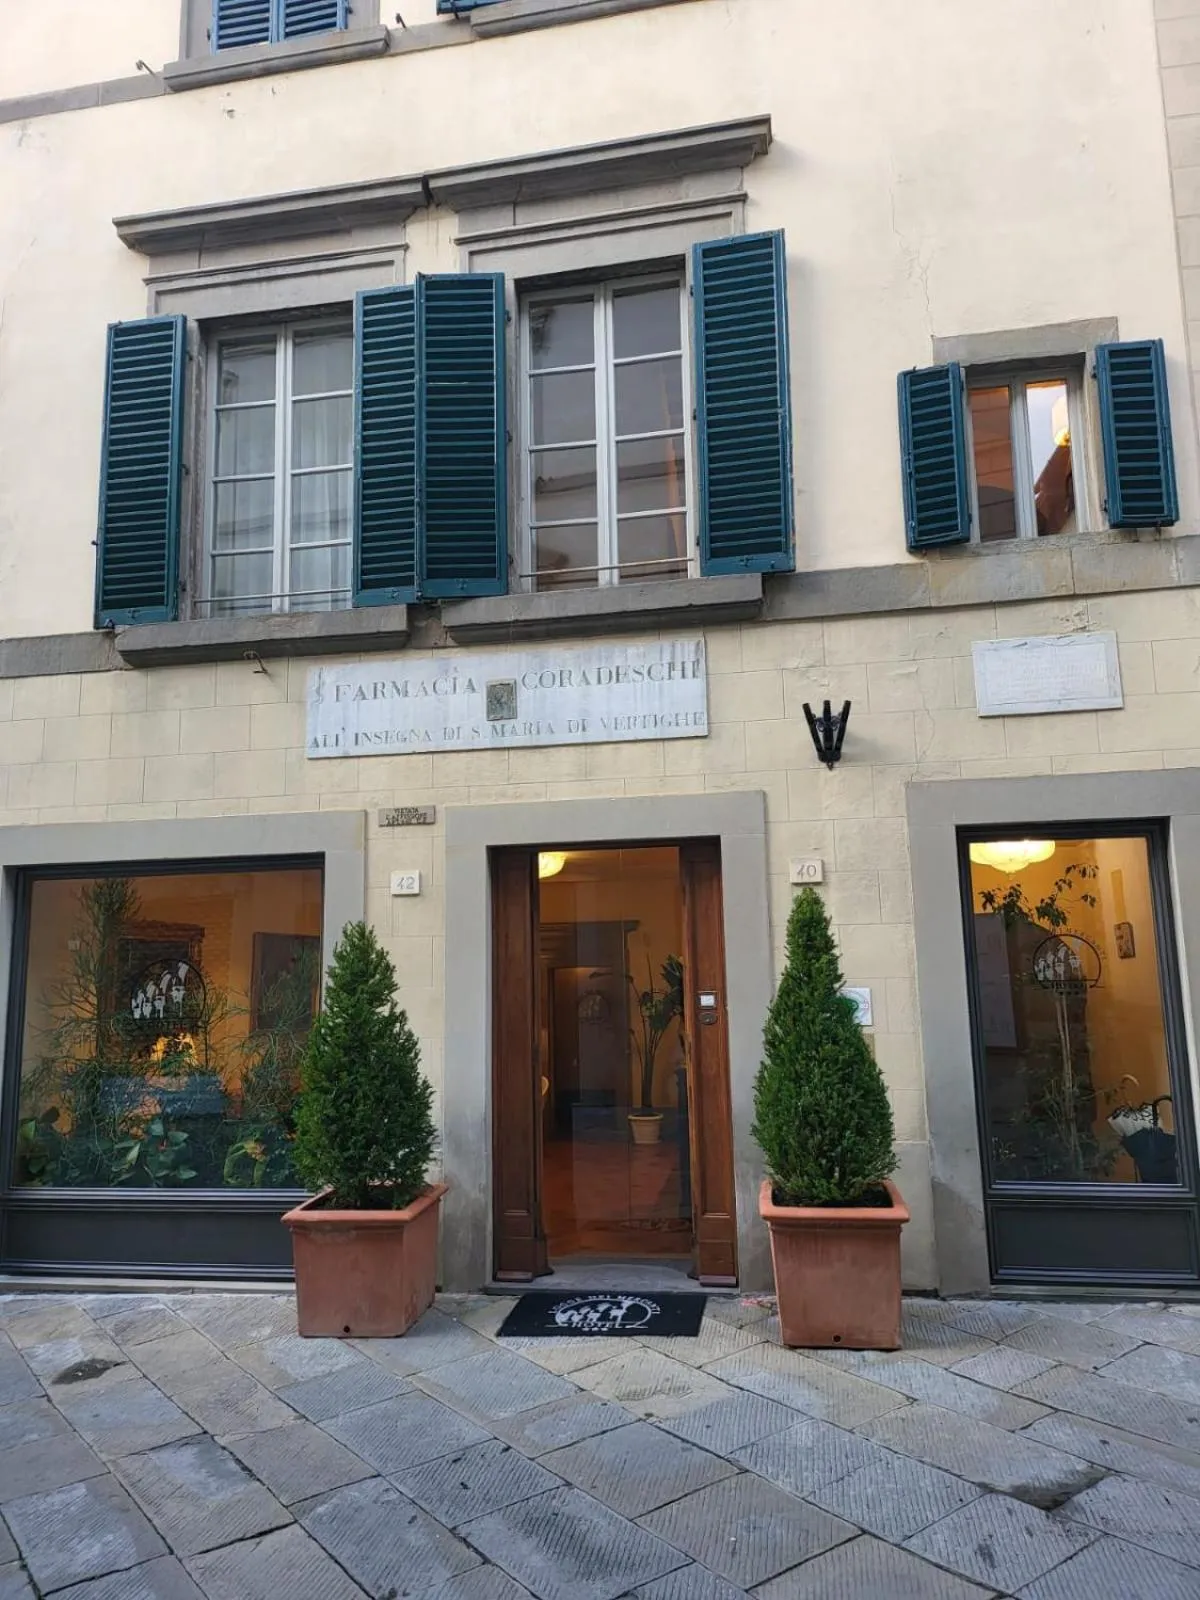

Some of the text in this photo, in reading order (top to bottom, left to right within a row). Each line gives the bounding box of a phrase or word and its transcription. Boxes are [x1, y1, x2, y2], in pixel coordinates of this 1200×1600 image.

[521, 658, 700, 691] CORADESCHI
[442, 726, 463, 742] DI
[490, 720, 556, 738] MARIA
[567, 718, 589, 734] DI
[600, 711, 706, 732] VERTIGHE
[396, 876, 416, 890] 42
[796, 863, 818, 881] 40
